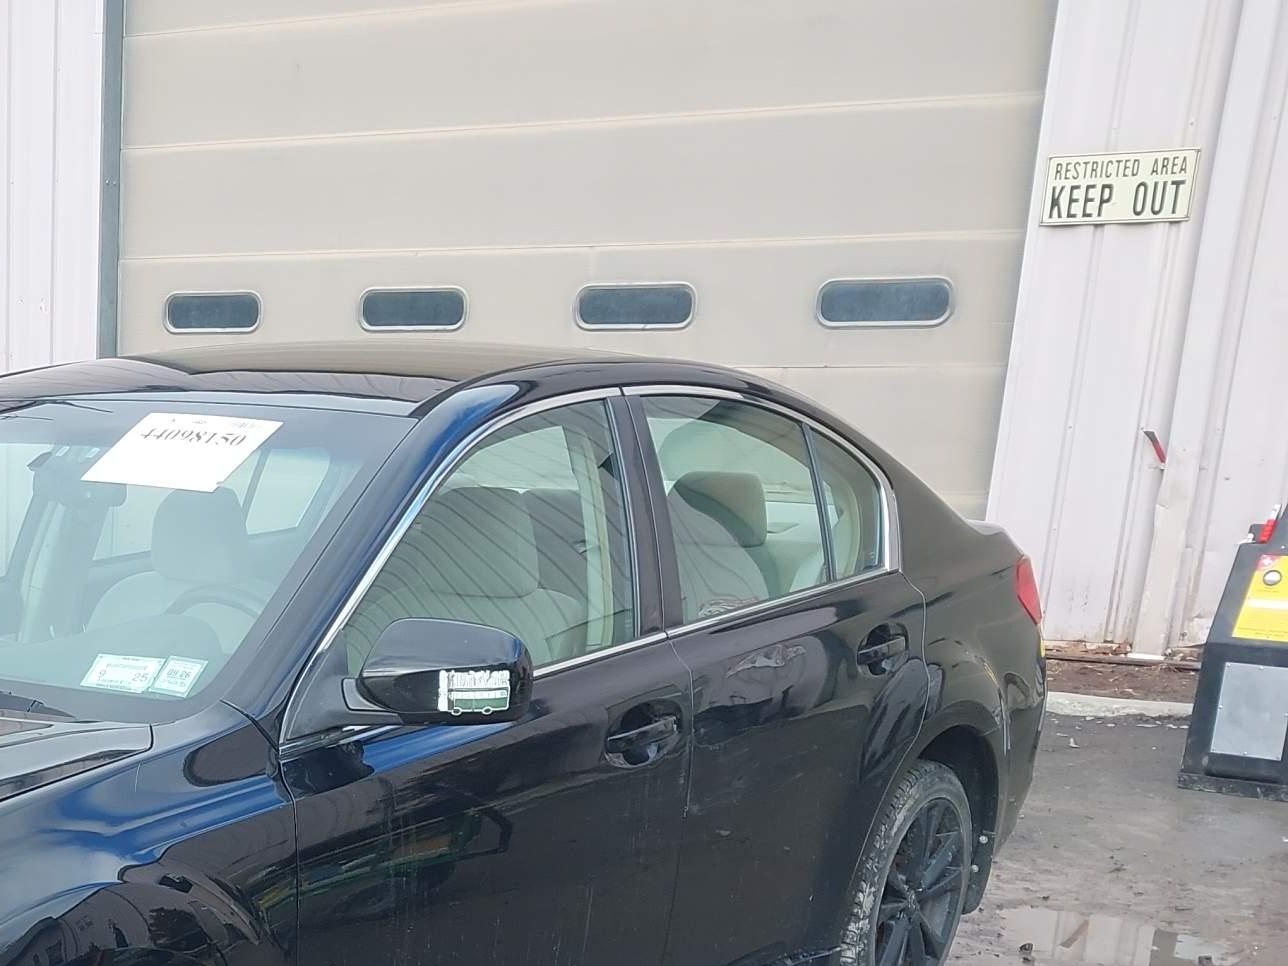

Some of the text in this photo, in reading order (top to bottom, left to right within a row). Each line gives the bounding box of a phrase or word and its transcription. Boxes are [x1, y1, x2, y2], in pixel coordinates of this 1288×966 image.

[1054, 155, 1188, 181] RESTRICTED AREA
[1048, 179, 1187, 219] KEEP OUT
[140, 427, 247, 447] 44098150
